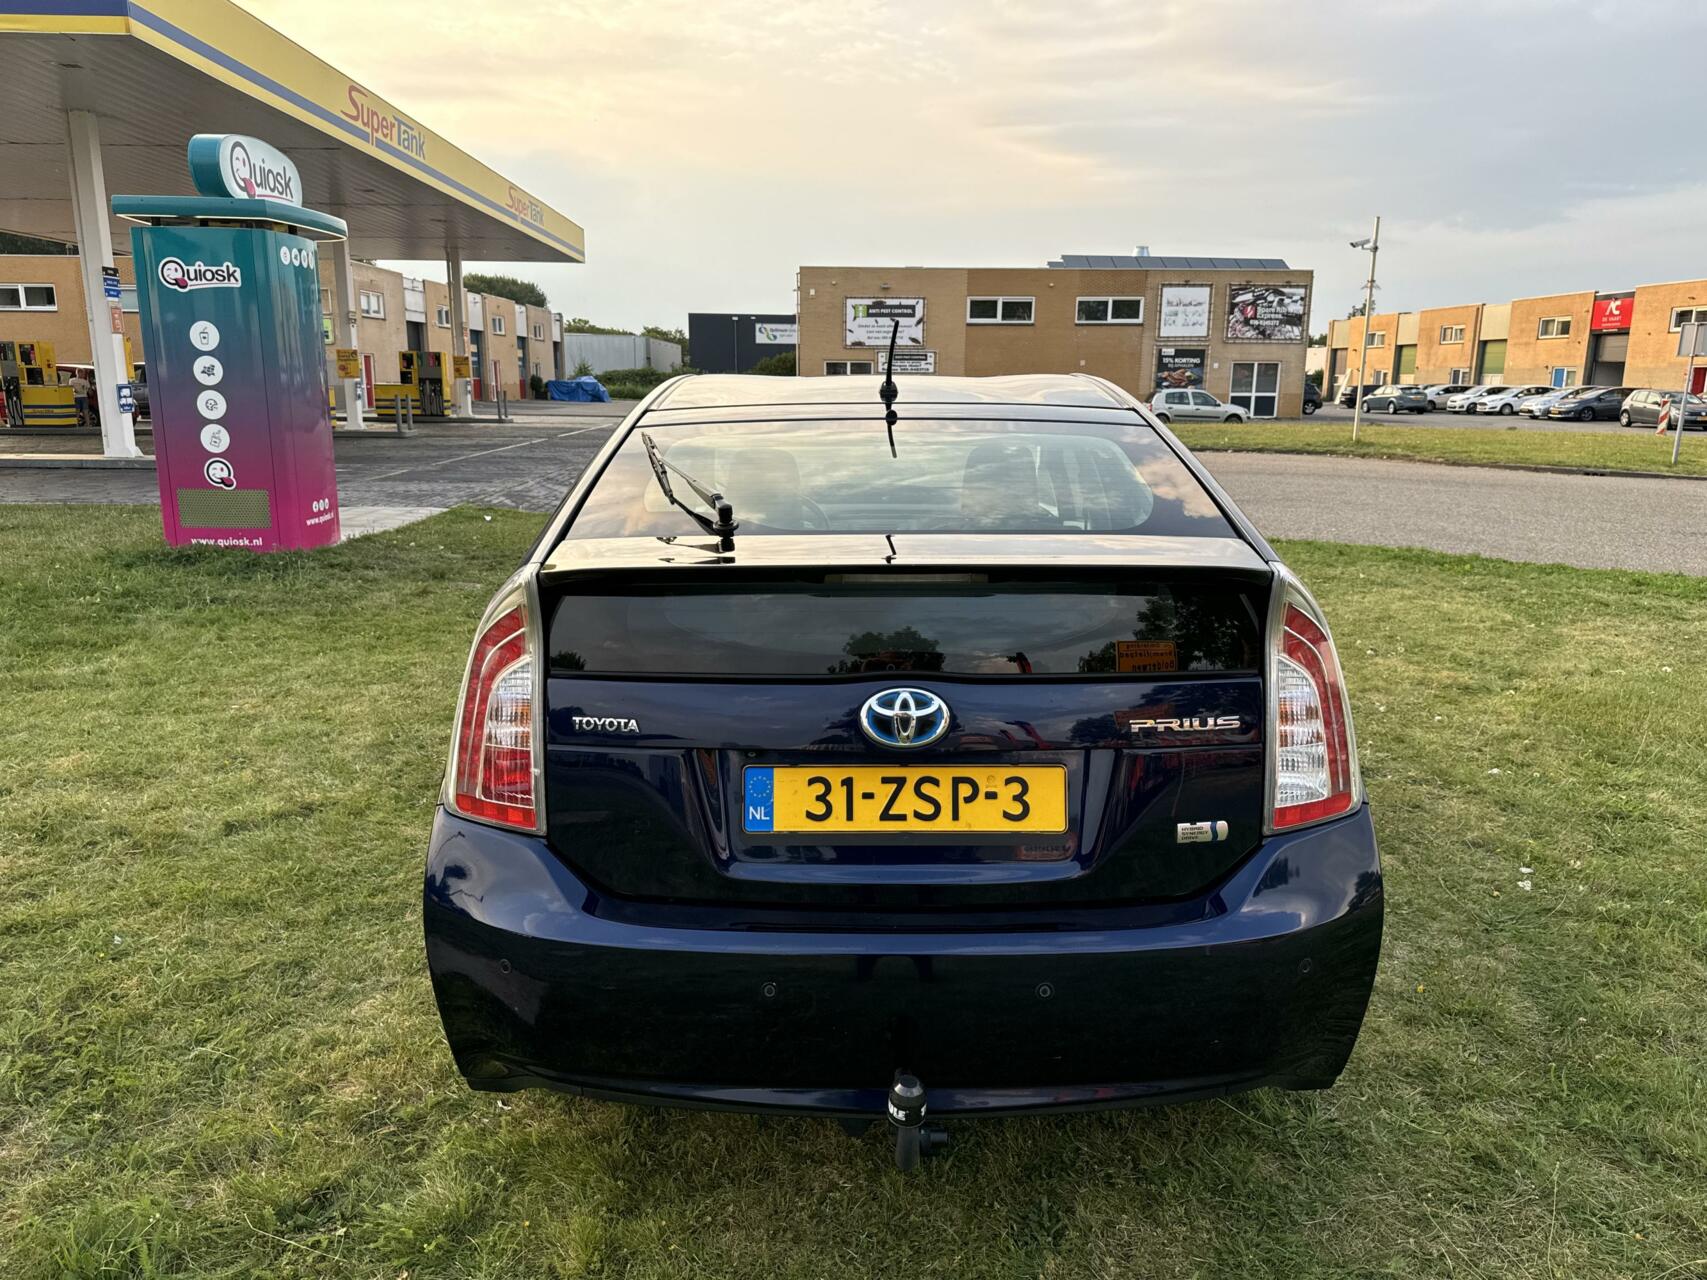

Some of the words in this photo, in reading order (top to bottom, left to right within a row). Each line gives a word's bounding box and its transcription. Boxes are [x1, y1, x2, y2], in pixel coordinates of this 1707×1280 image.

[230, 141, 294, 199] Quiosk
[161, 260, 239, 289] Quiosk
[572, 716, 640, 733] TOYOTA
[1129, 715, 1241, 733] PRIUS
[805, 776, 1031, 822] 31-ZSP-3
[749, 805, 770, 821] NL
